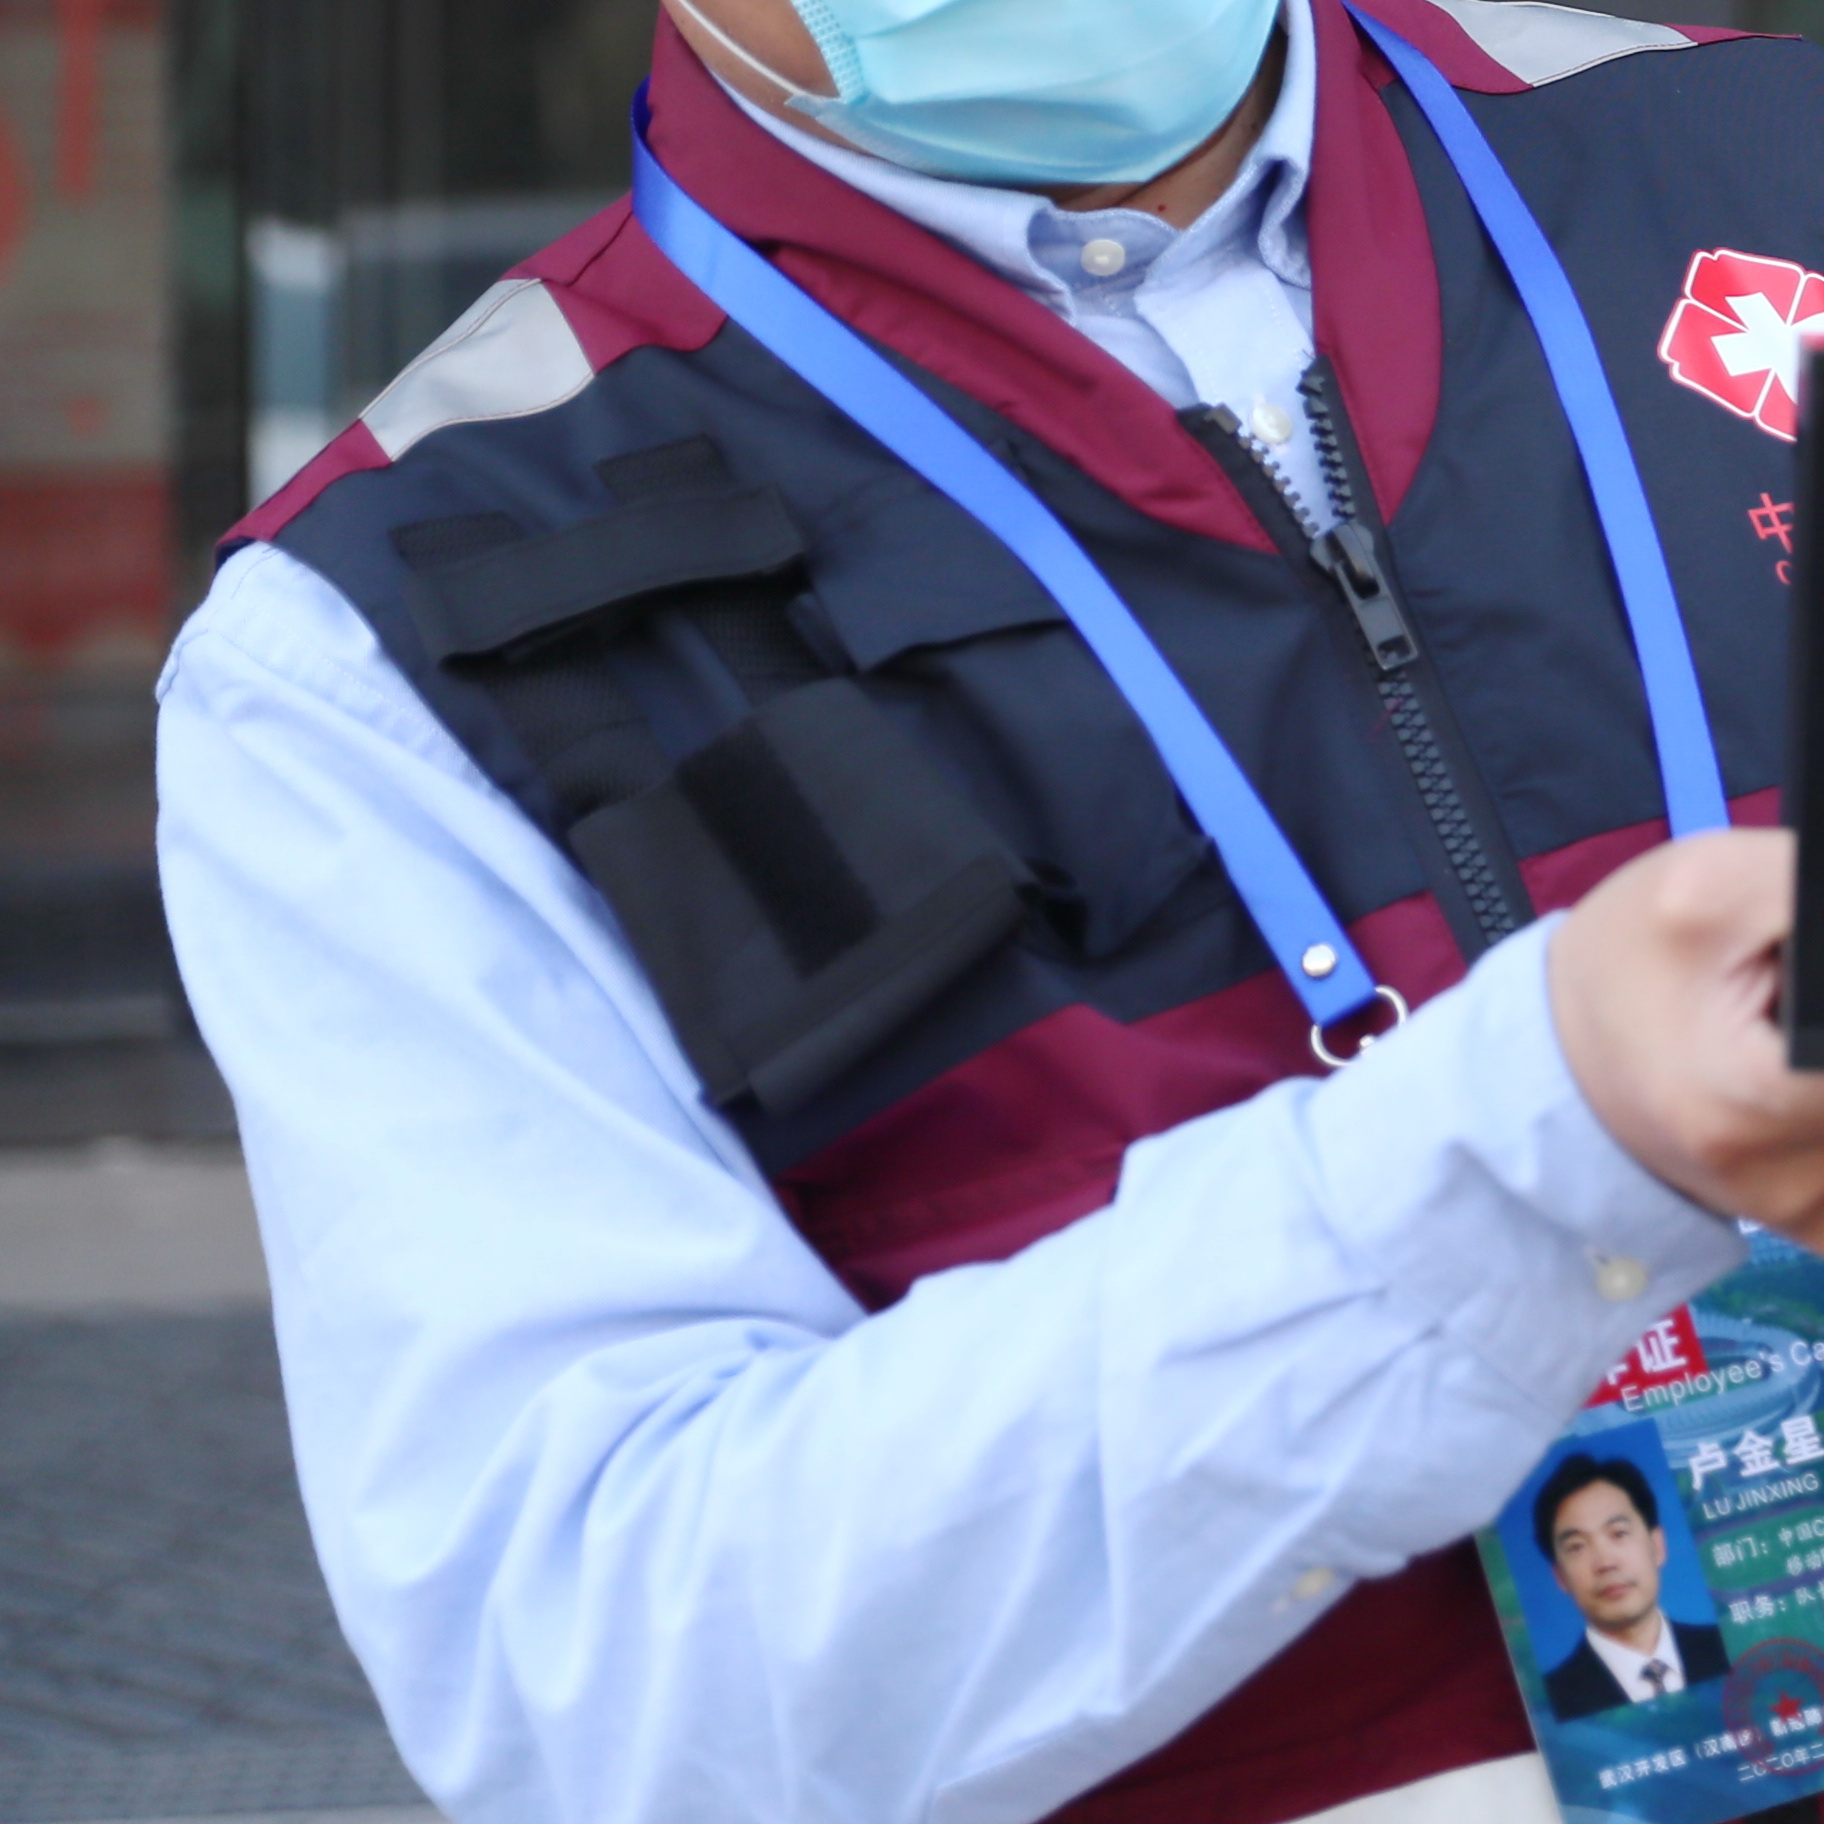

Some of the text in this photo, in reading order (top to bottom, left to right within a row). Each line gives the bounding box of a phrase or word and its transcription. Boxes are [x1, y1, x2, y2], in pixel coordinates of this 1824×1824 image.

[1620, 1348, 1785, 1413] Employee's
[1703, 1473, 1820, 1520] LU JINXING
